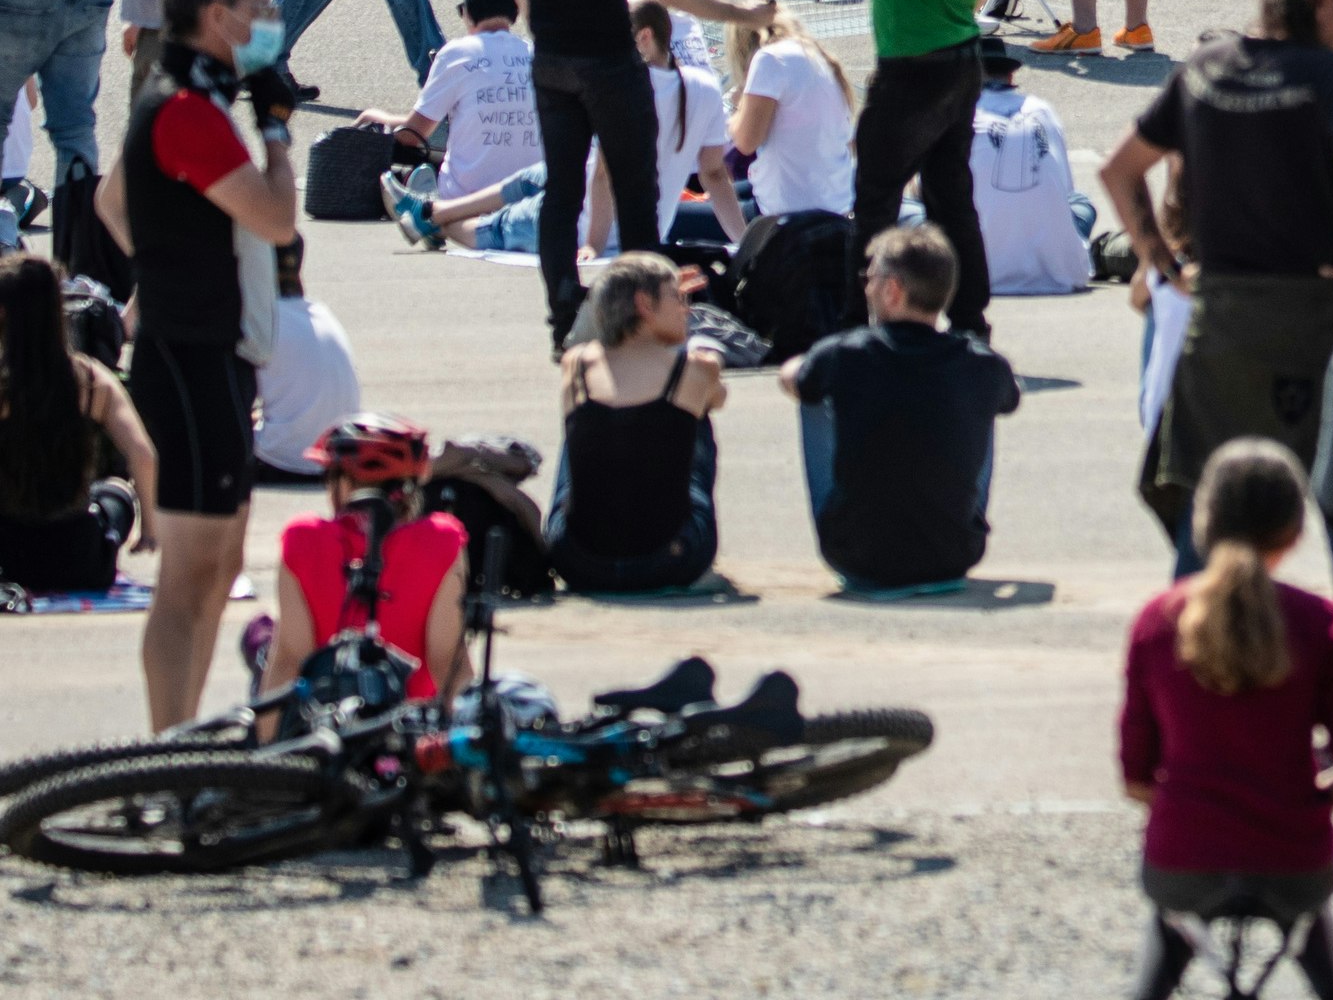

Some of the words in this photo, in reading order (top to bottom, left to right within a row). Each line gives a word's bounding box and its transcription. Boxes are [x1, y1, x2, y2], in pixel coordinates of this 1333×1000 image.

[463, 58, 491, 73] WO
[476, 86, 527, 104] RECHT
[481, 131, 512, 146] ZUR
